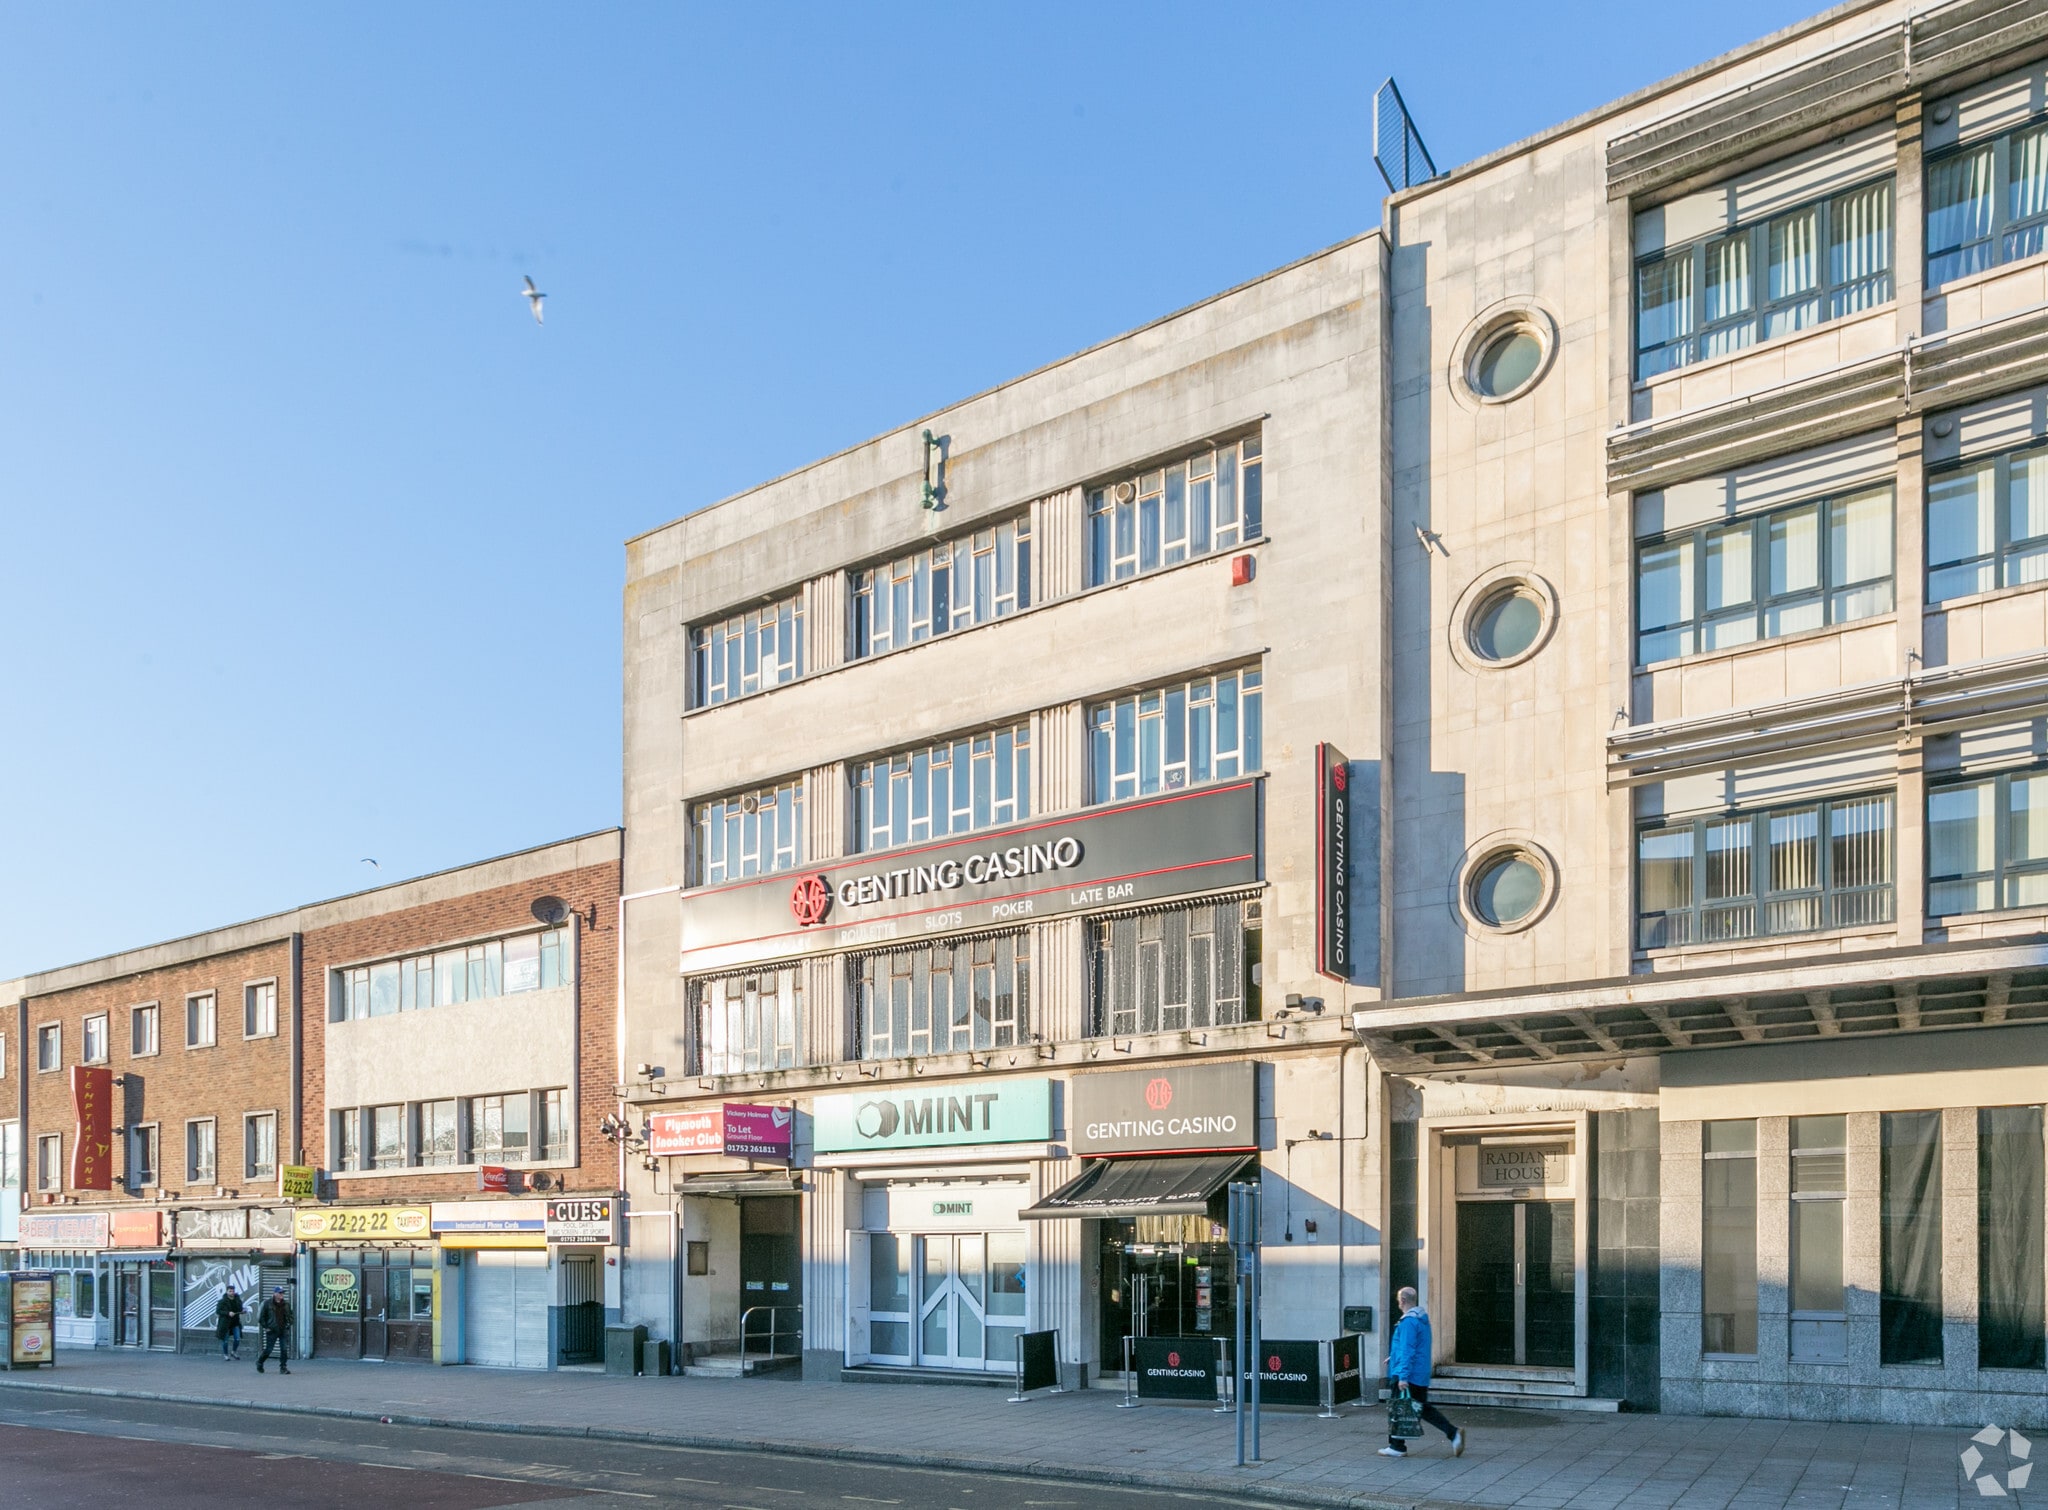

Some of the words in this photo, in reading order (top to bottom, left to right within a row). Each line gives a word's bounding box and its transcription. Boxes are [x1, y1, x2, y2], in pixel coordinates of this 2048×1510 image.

[1335, 798, 1344, 886] GENTING
[838, 860, 959, 907] GENTING
[965, 836, 1081, 884] CASINO
[1070, 887, 1103, 905] LATE
[1107, 883, 1134, 899] BAR
[992, 900, 1033, 918] POKER
[925, 911, 962, 930] SLOTS
[1336, 889, 1344, 965] CASINO
[726, 1110, 747, 1119] Vickery
[747, 1111, 769, 1119] Holman
[904, 1093, 999, 1136] MINT
[84, 1071, 94, 1185] TEMPTATIONS
[665, 1116, 712, 1133] Plymouth
[727, 1124, 737, 1133] To
[738, 1125, 751, 1133] Let
[1086, 1119, 1165, 1140] GENTING
[1167, 1115, 1237, 1135] CASINO
[656, 1136, 695, 1148] Snooker
[697, 1132, 722, 1146] Club
[727, 1144, 748, 1152] 01752
[750, 1145, 776, 1153] 261811
[1485, 1150, 1560, 1165] RADIANT
[1495, 1166, 1550, 1180] HOUSE
[284, 1179, 313, 1194] 22-22-22
[556, 1202, 602, 1221] CUES
[946, 1203, 972, 1214] MINT
[30, 1220, 56, 1237] BEST
[57, 1218, 95, 1237] KEBAB
[211, 1213, 245, 1238] RAW
[330, 1212, 388, 1233] 22-22-22
[324, 1274, 352, 1286] TAXIFIRST
[316, 1288, 359, 1314] 22-22-22
[1147, 1368, 1179, 1377] GENTING
[1179, 1369, 1206, 1378] CASINO
[1243, 1371, 1278, 1381] GETING
[1278, 1372, 1308, 1382] CASINO
